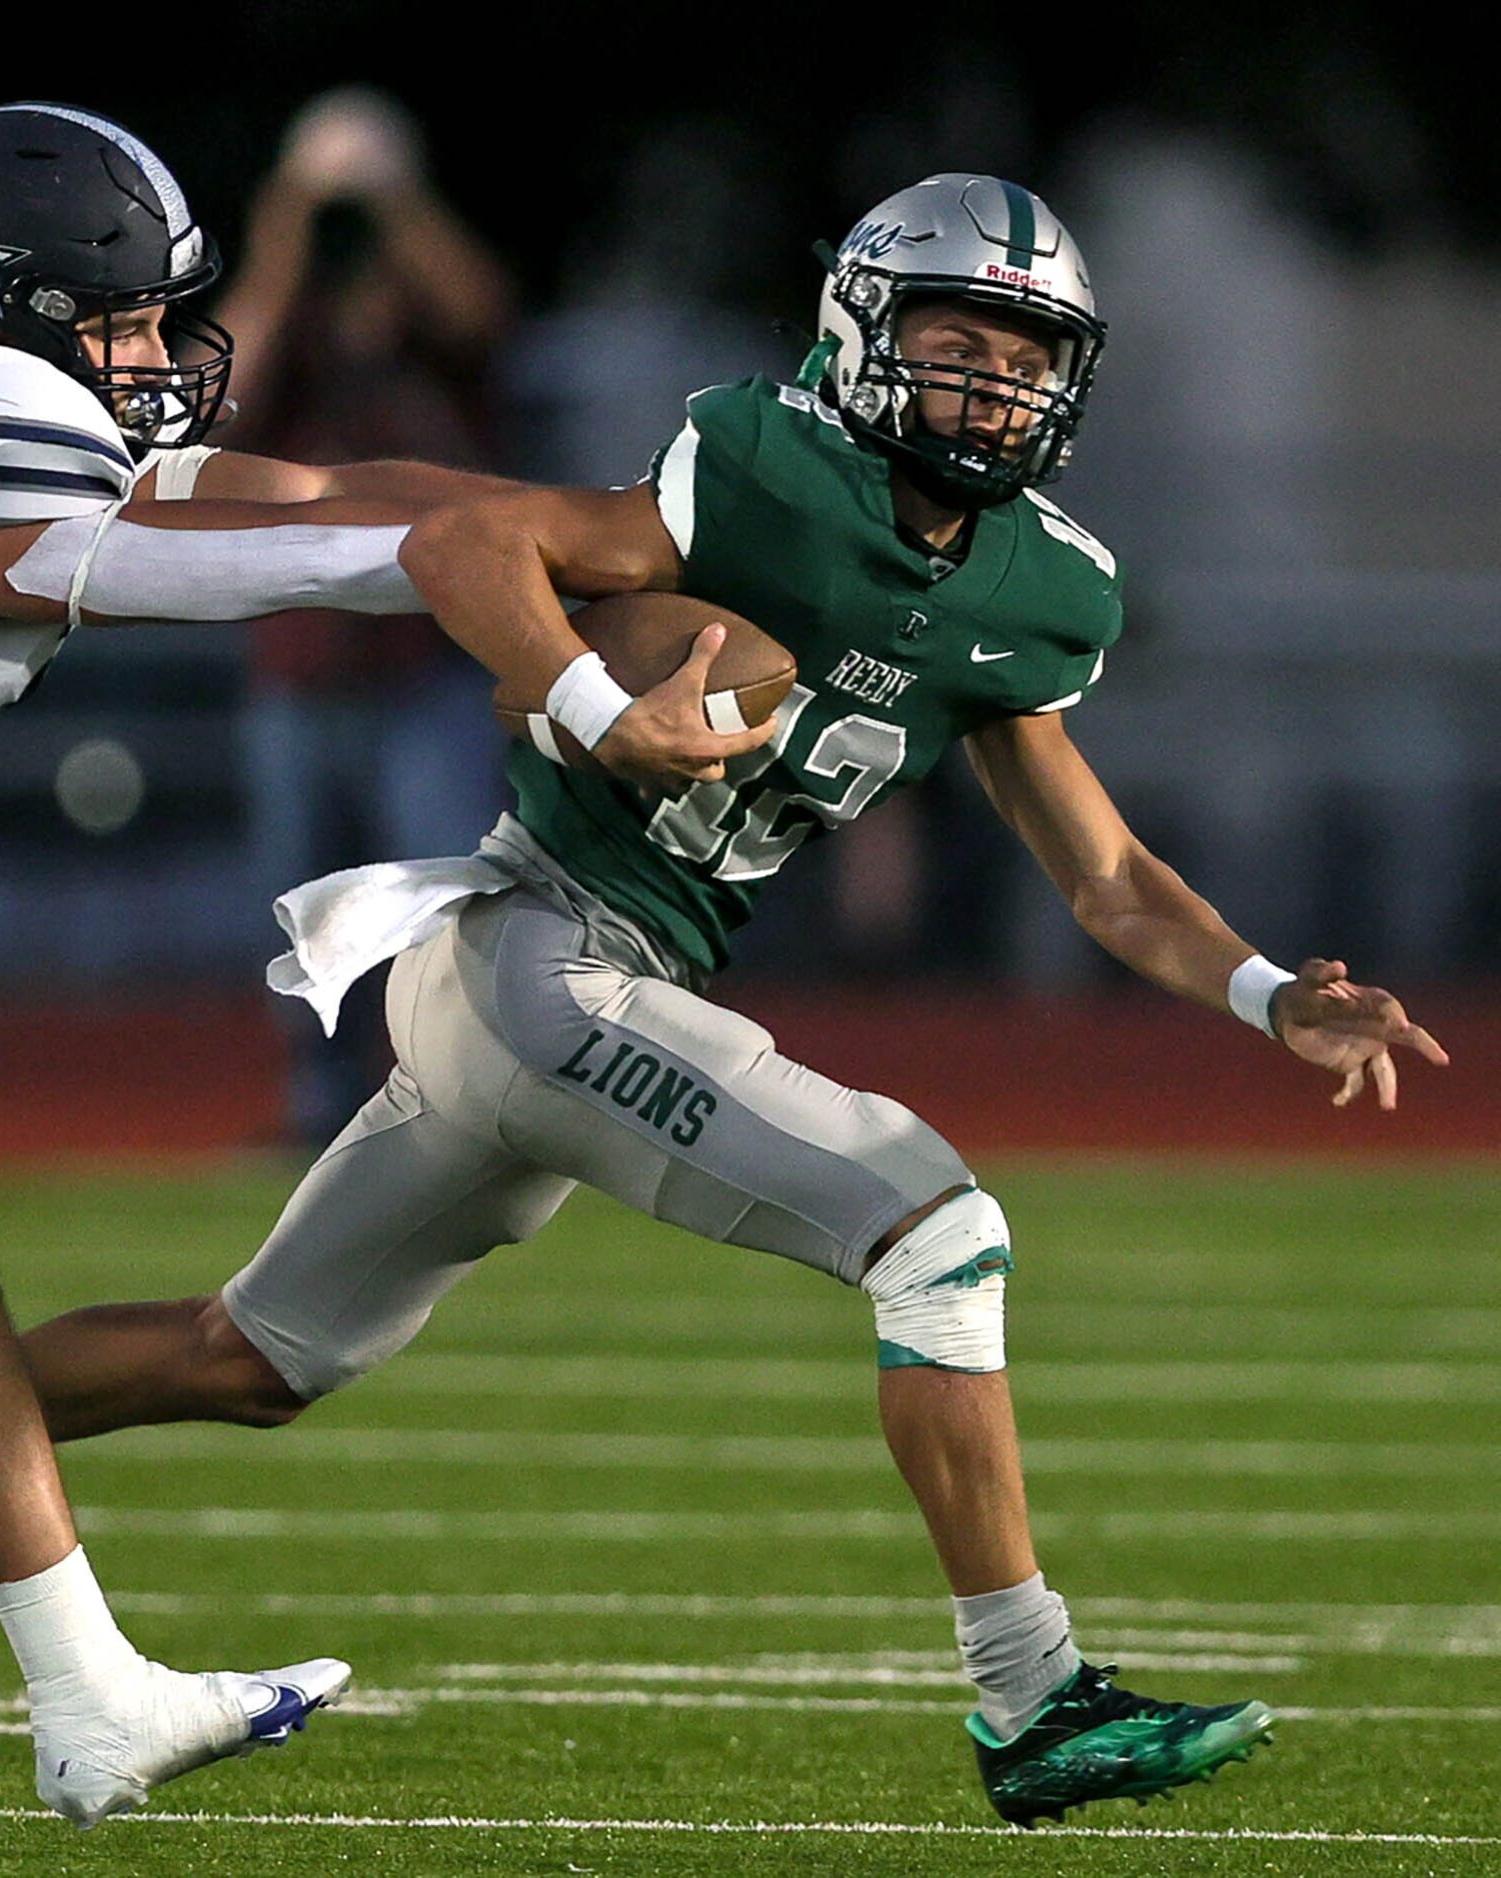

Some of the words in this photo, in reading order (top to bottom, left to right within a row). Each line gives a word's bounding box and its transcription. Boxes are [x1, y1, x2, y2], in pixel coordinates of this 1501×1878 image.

[825, 648, 918, 707] REEDY
[645, 683, 907, 881] 12
[557, 1029, 717, 1147] LIONS
